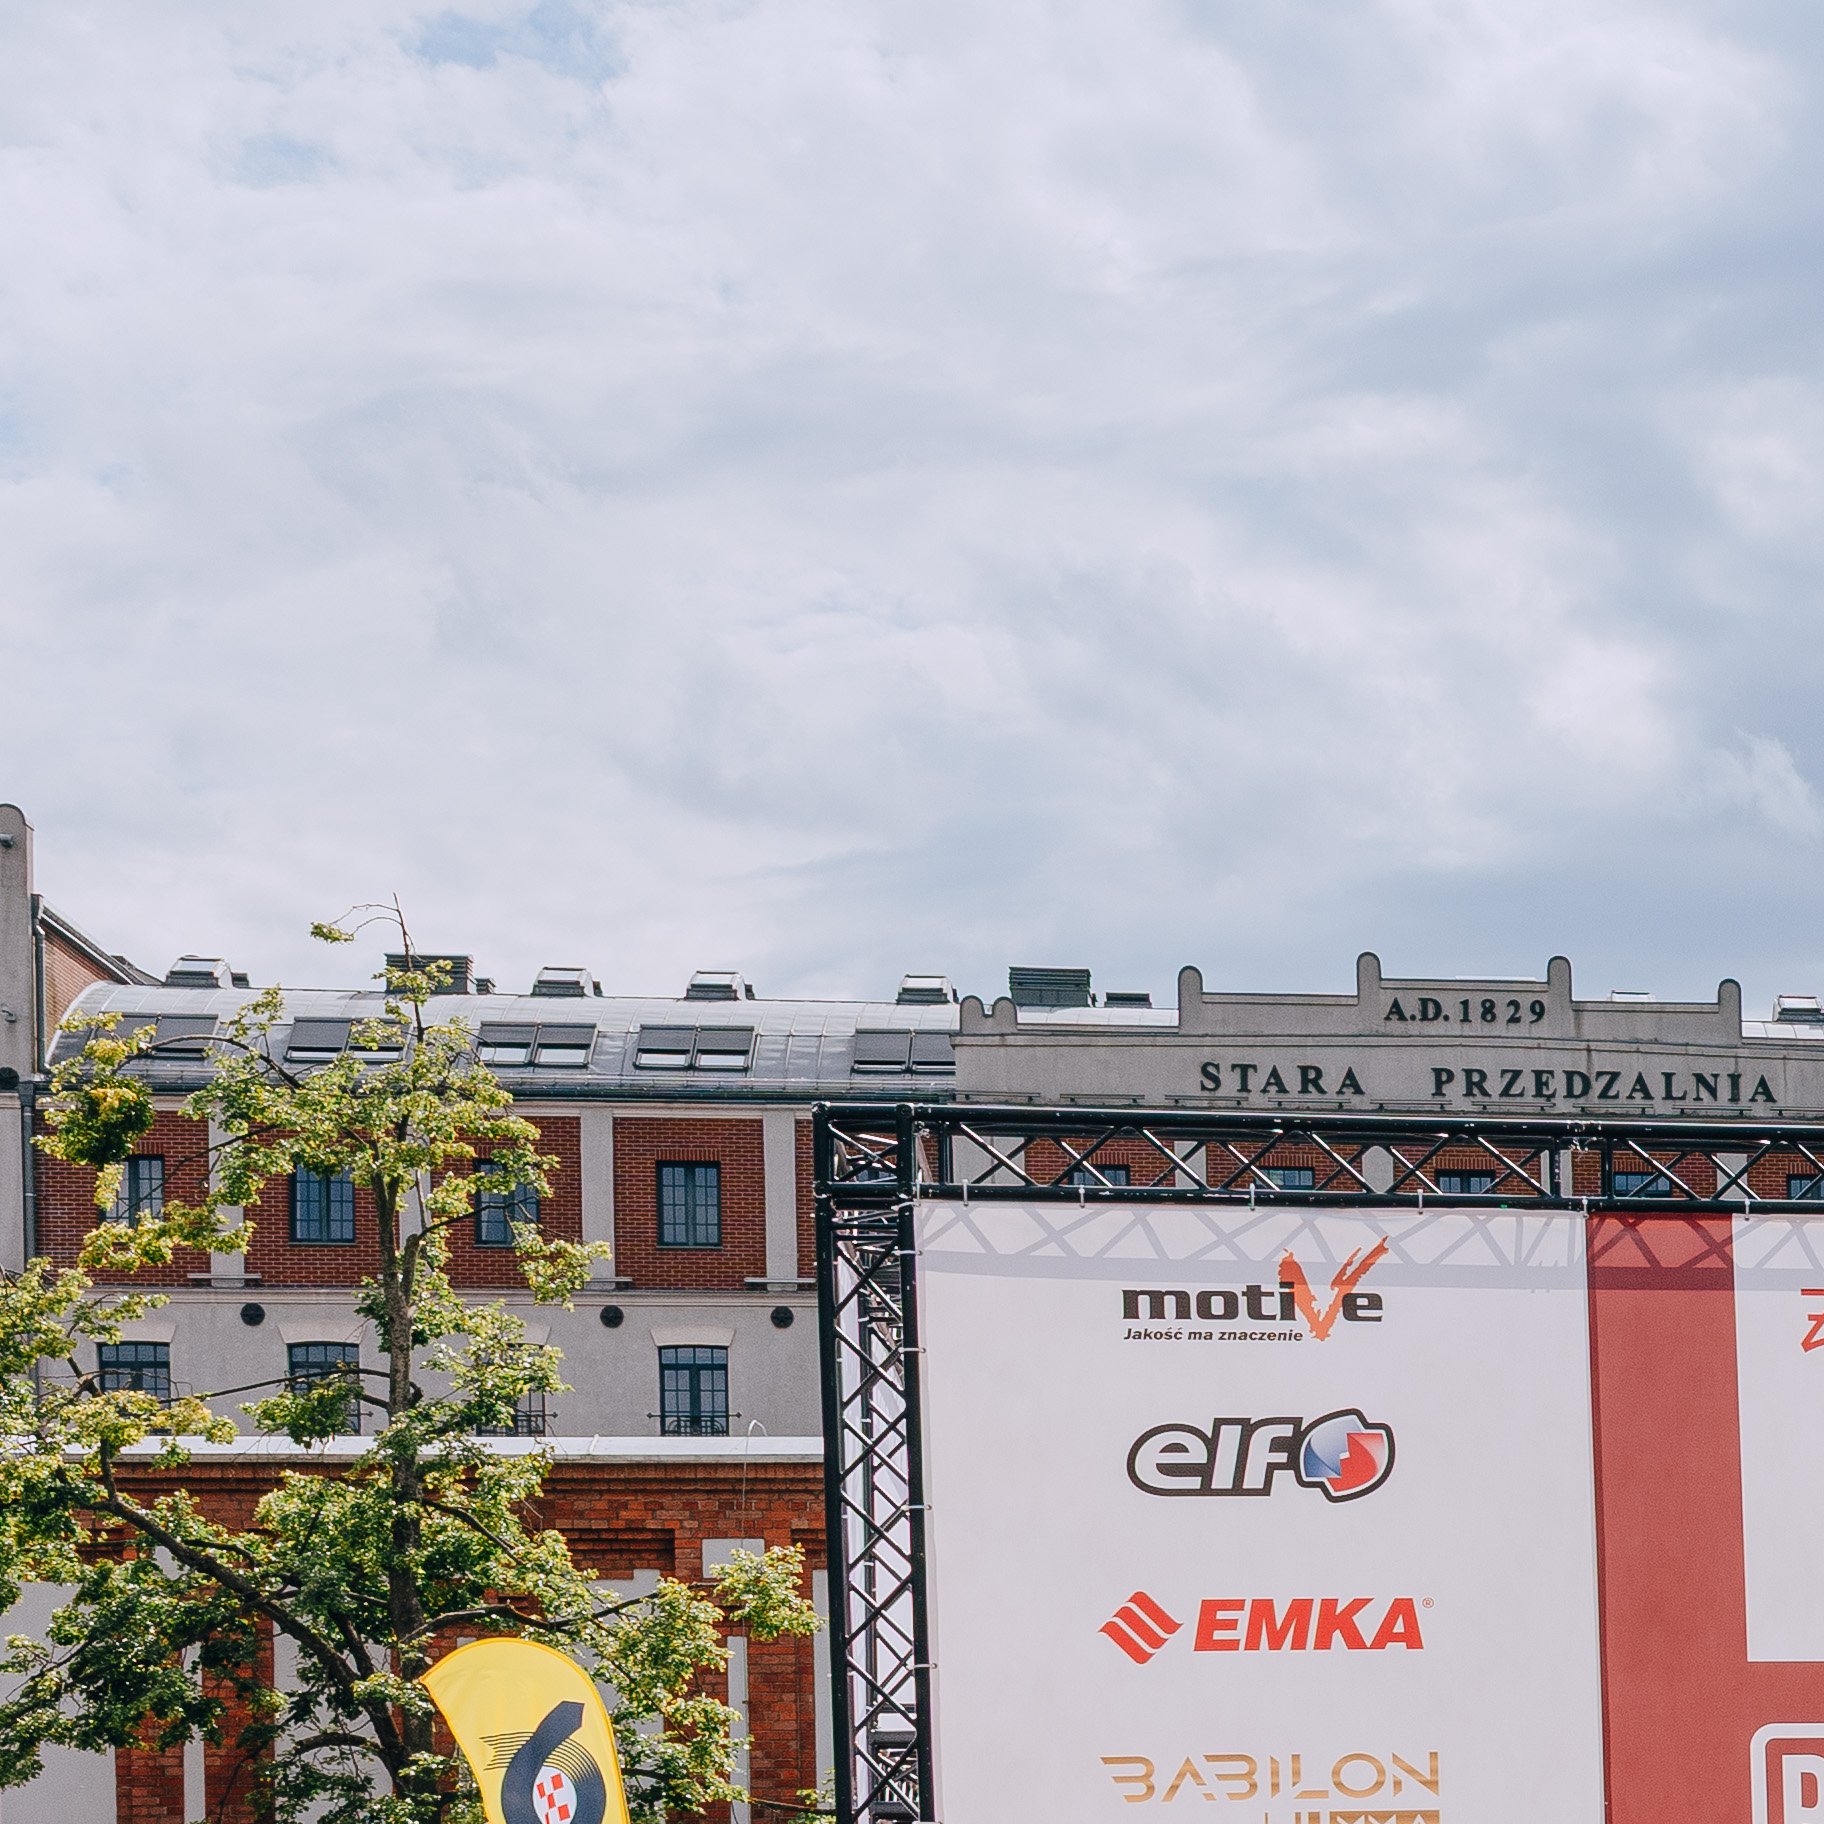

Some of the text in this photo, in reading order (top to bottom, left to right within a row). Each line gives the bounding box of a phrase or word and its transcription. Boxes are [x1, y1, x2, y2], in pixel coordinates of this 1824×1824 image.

[1200, 1061, 1366, 1095] STARA
[1123, 1327, 1303, 1342] Jakość ma znaczenie
[1130, 1418, 1298, 1491] elf
[1100, 1752, 1440, 1803] BABILON
